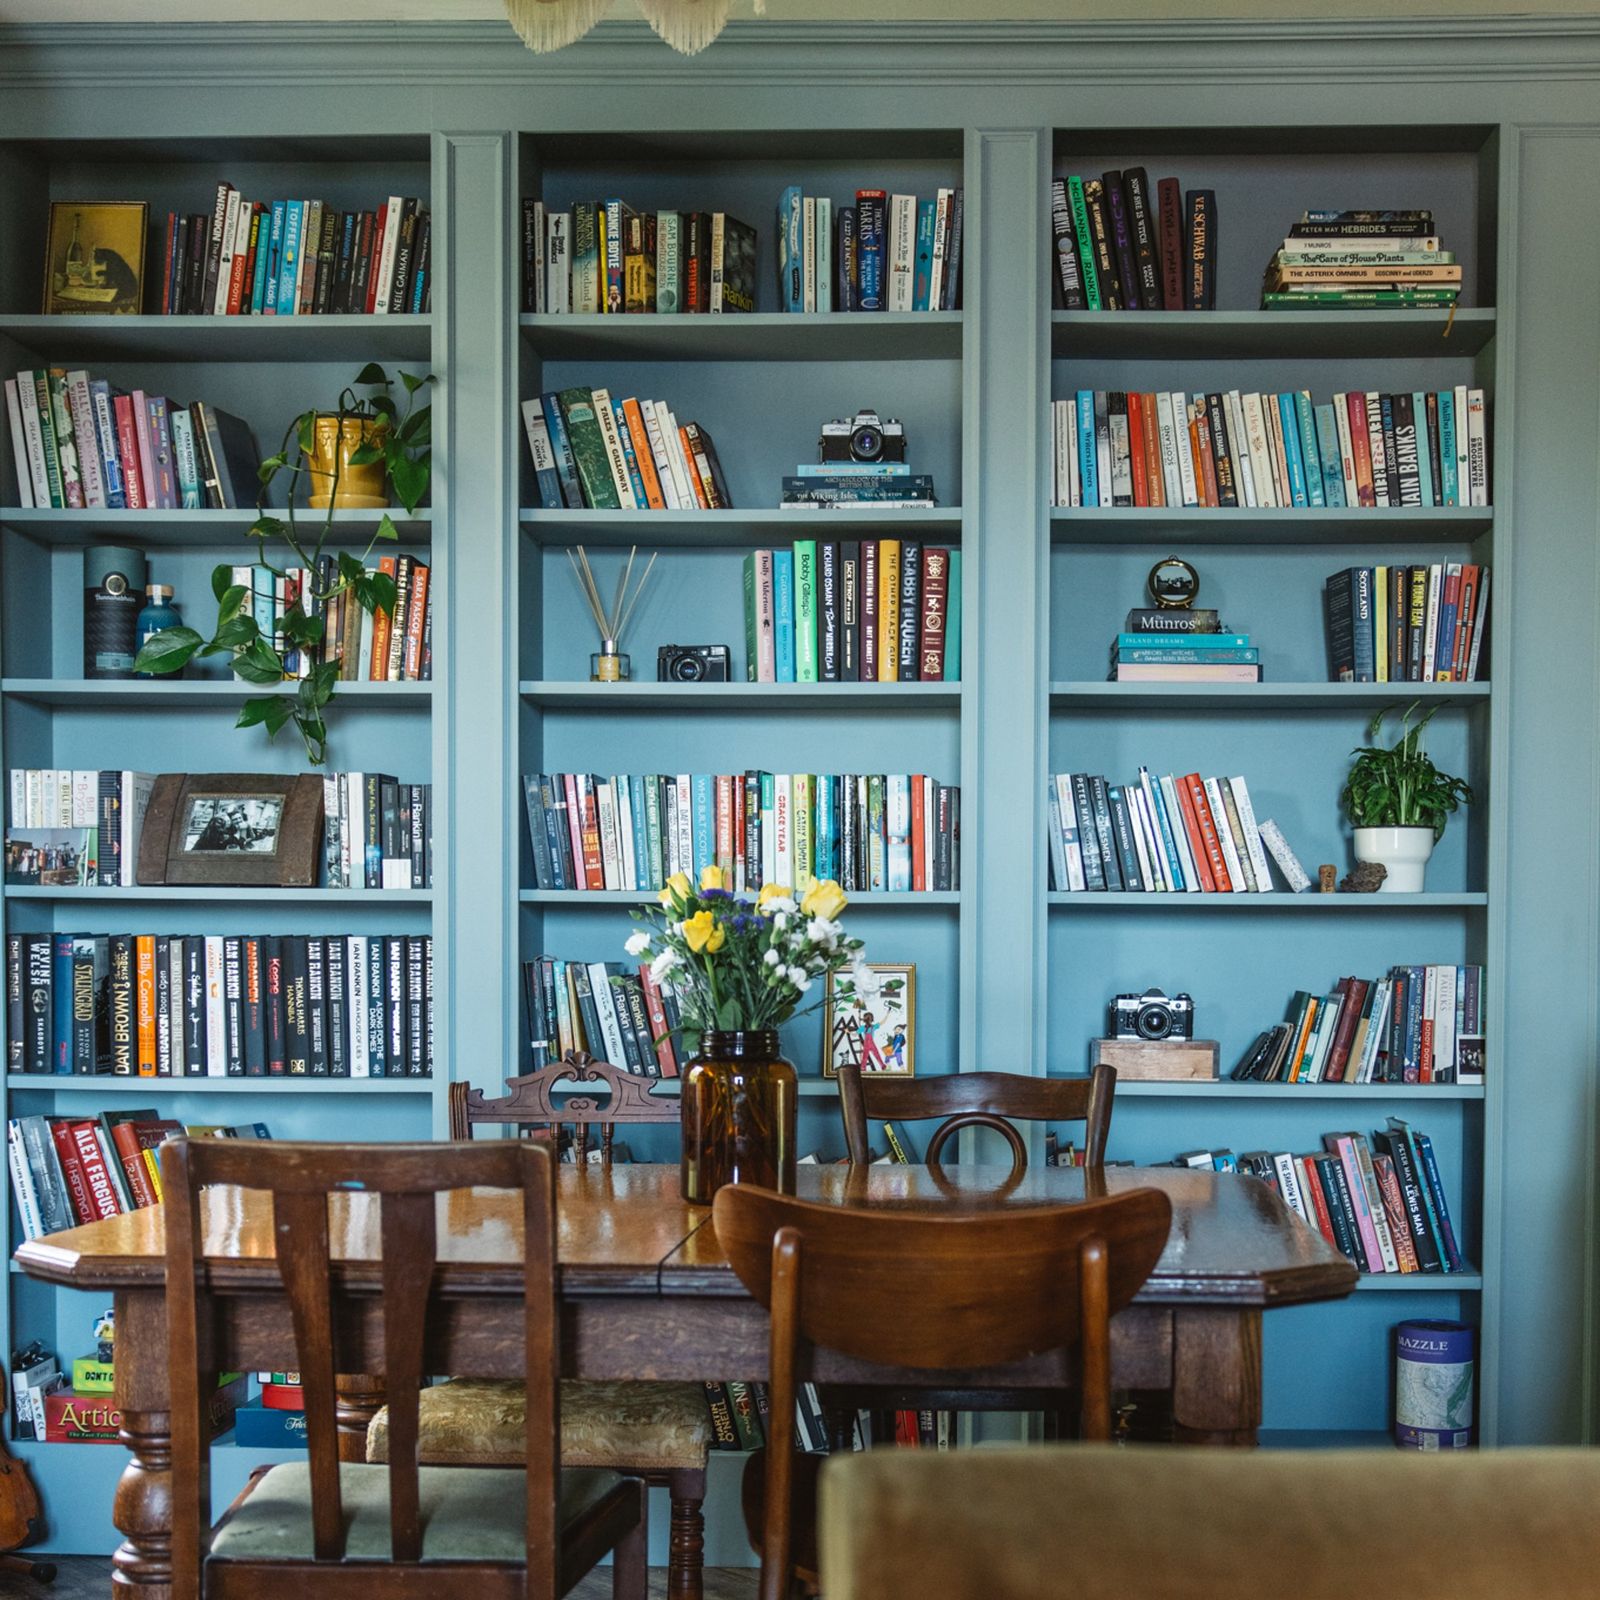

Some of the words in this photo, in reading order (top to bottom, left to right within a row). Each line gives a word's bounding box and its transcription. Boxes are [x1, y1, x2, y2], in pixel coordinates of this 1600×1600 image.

[1133, 196, 1142, 211] SHE
[272, 206, 283, 241] Natives
[287, 207, 299, 247] TOFFEE
[607, 202, 620, 239] FRANKIE
[666, 218, 676, 240] SAM
[859, 201, 874, 241] HARRIS
[873, 207, 883, 236] THOMAS
[1137, 220, 1148, 245] WITCH
[1341, 225, 1387, 234] HEBRIDES
[712, 233, 723, 269] Rankin
[1071, 181, 1089, 248] McILVANNEY
[1083, 261, 1097, 303] RANKIN
[1193, 213, 1206, 261] SCHWAB
[234, 256, 243, 281] RODDY
[396, 249, 409, 288] GAIMAN
[607, 241, 619, 269] BOYLE
[666, 243, 677, 288] BOURNE
[1340, 253, 1348, 264] of
[1376, 253, 1405, 263] Plants
[582, 260, 594, 302] Scotland
[1059, 252, 1080, 292] MEANTIME
[1290, 270, 1304, 278] THE
[1304, 270, 1335, 278] ASTERIX
[1336, 270, 1368, 278] OMNIBUS
[231, 283, 240, 306] DOYLE
[266, 278, 277, 305] Akala
[392, 290, 403, 312] NEIL
[76, 381, 91, 417] BILLY
[600, 406, 614, 433] TALES
[615, 407, 625, 425] NICK
[1367, 398, 1384, 435] KILEY
[1441, 400, 1452, 431] Malibu
[607, 434, 616, 447] OF
[1164, 425, 1174, 467] SCOTLAND
[1394, 425, 1419, 475] BANKS
[1442, 431, 1453, 459] Rising
[611, 448, 629, 494] GALLOWAY
[1470, 437, 1479, 488] BROOKMYRE
[126, 470, 140, 509] QUEENIE
[1374, 468, 1389, 498] REID
[759, 555, 770, 578] Dolly
[823, 545, 834, 578] RICHARD
[866, 545, 874, 559] THE
[799, 553, 811, 582] Bobby
[865, 560, 874, 597] VANISHING
[901, 547, 919, 605] SCABBY
[1414, 570, 1426, 583] THE
[414, 576, 425, 599] SARA
[762, 579, 770, 615] Alderton
[801, 582, 812, 618] Gillespie
[824, 578, 835, 607] OSMAN
[1358, 570, 1368, 620] SCOTLAND
[410, 602, 422, 635] PASCOE
[865, 598, 874, 616] HALF
[1410, 608, 1424, 627] TEAM
[1141, 616, 1196, 630] Munros
[900, 618, 917, 667] QUEEN
[411, 787, 421, 802] Ian
[697, 778, 706, 804] WHO
[720, 779, 730, 815] JASPER
[1076, 777, 1088, 806] PETER
[411, 803, 423, 839] Rankin
[698, 805, 707, 829] BUILT
[1080, 807, 1092, 826] MAY
[698, 829, 708, 872] SCOTLA
[777, 828, 787, 853] YEAR
[1096, 815, 1112, 863] CHESSMEN
[30, 942, 41, 986] WELSH
[39, 942, 51, 986] IRVINE
[138, 952, 152, 977] Billy
[225, 940, 239, 959] IAN
[308, 942, 321, 960] IAN
[328, 942, 341, 960] IAN
[353, 943, 361, 961] IAN
[371, 943, 380, 961] IAN
[390, 941, 401, 961] IAN
[409, 942, 421, 960] IAN
[158, 969, 168, 990] Open
[226, 961, 240, 999] RANKIN
[269, 958, 281, 995] Keane
[309, 962, 322, 1000] RANKIN
[328, 962, 342, 1000] RANKIN
[353, 961, 362, 997] RANKIN
[371, 962, 380, 998] RANKIN
[390, 961, 401, 1002] RANKIN
[409, 962, 422, 1001] RANKIN
[74, 964, 94, 1022] STALINGRAD
[138, 979, 153, 1029] Connolly
[159, 991, 168, 1013] Doors
[286, 984, 296, 1025] HANNIBAL
[295, 976, 304, 1009] THOMAS
[1439, 974, 1449, 1012] FAULKS
[113, 990, 131, 1043] BROWN
[296, 1010, 306, 1036] HARRIS
[369, 1007, 377, 1028] DARK
[614, 993, 632, 1029] Rankin
[630, 994, 647, 1030] Rankin
[36, 1017, 45, 1055] SKAGBOYS
[369, 1029, 377, 1053] TIMES
[1424, 1021, 1432, 1046] RODDY
[113, 1045, 131, 1075] DAN
[1422, 1046, 1431, 1071] DOYLE
[74, 1129, 98, 1163] ALEX
[1397, 1143, 1410, 1165] PETER
[1334, 1164, 1347, 1188] STONE
[1402, 1166, 1413, 1181] MAY
[1340, 1194, 1355, 1223] DESTINY
[1404, 1184, 1419, 1213] LEWIS
[1411, 1214, 1426, 1236] MAN
[58, 1402, 120, 1432] Artic
[711, 1403, 726, 1442] MARTIN
